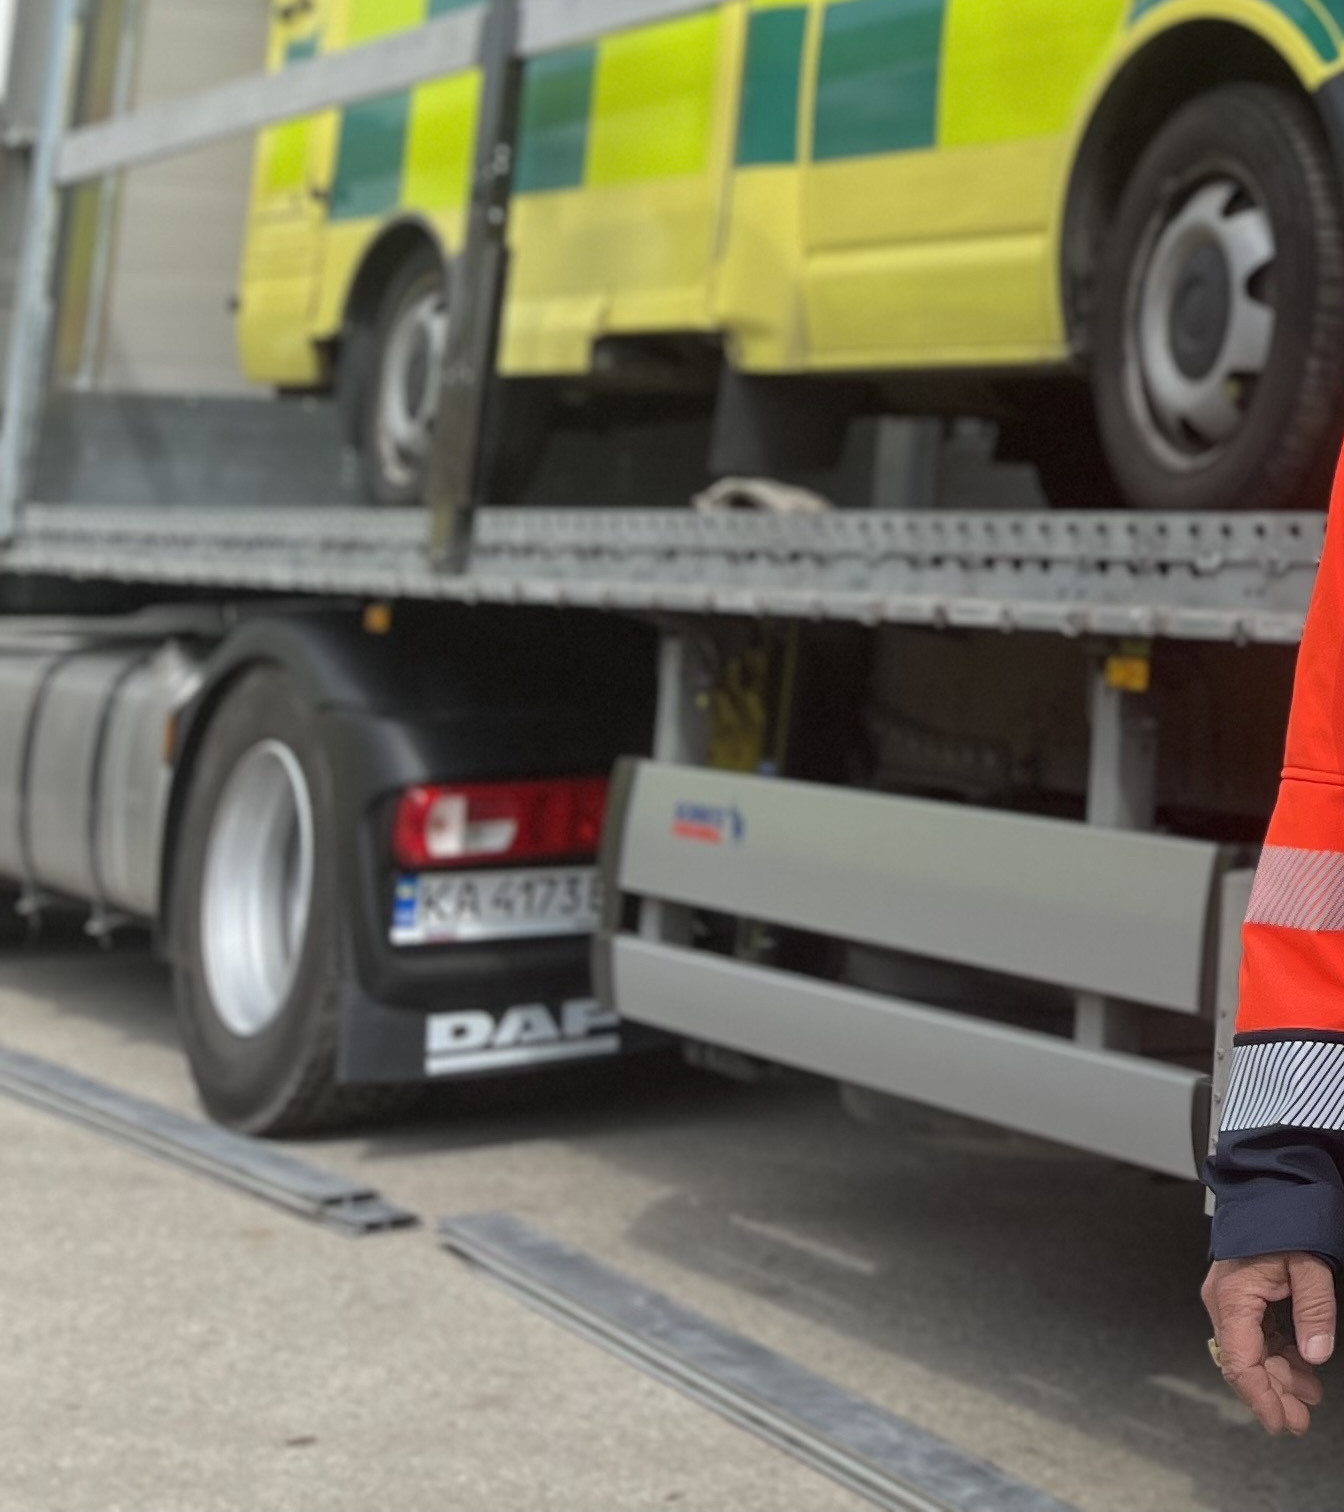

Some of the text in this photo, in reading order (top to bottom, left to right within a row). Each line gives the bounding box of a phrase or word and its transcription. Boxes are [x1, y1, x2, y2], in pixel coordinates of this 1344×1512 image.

[422, 878, 482, 921] KA
[489, 875, 582, 919] 4173
[426, 998, 620, 1051] DAF
